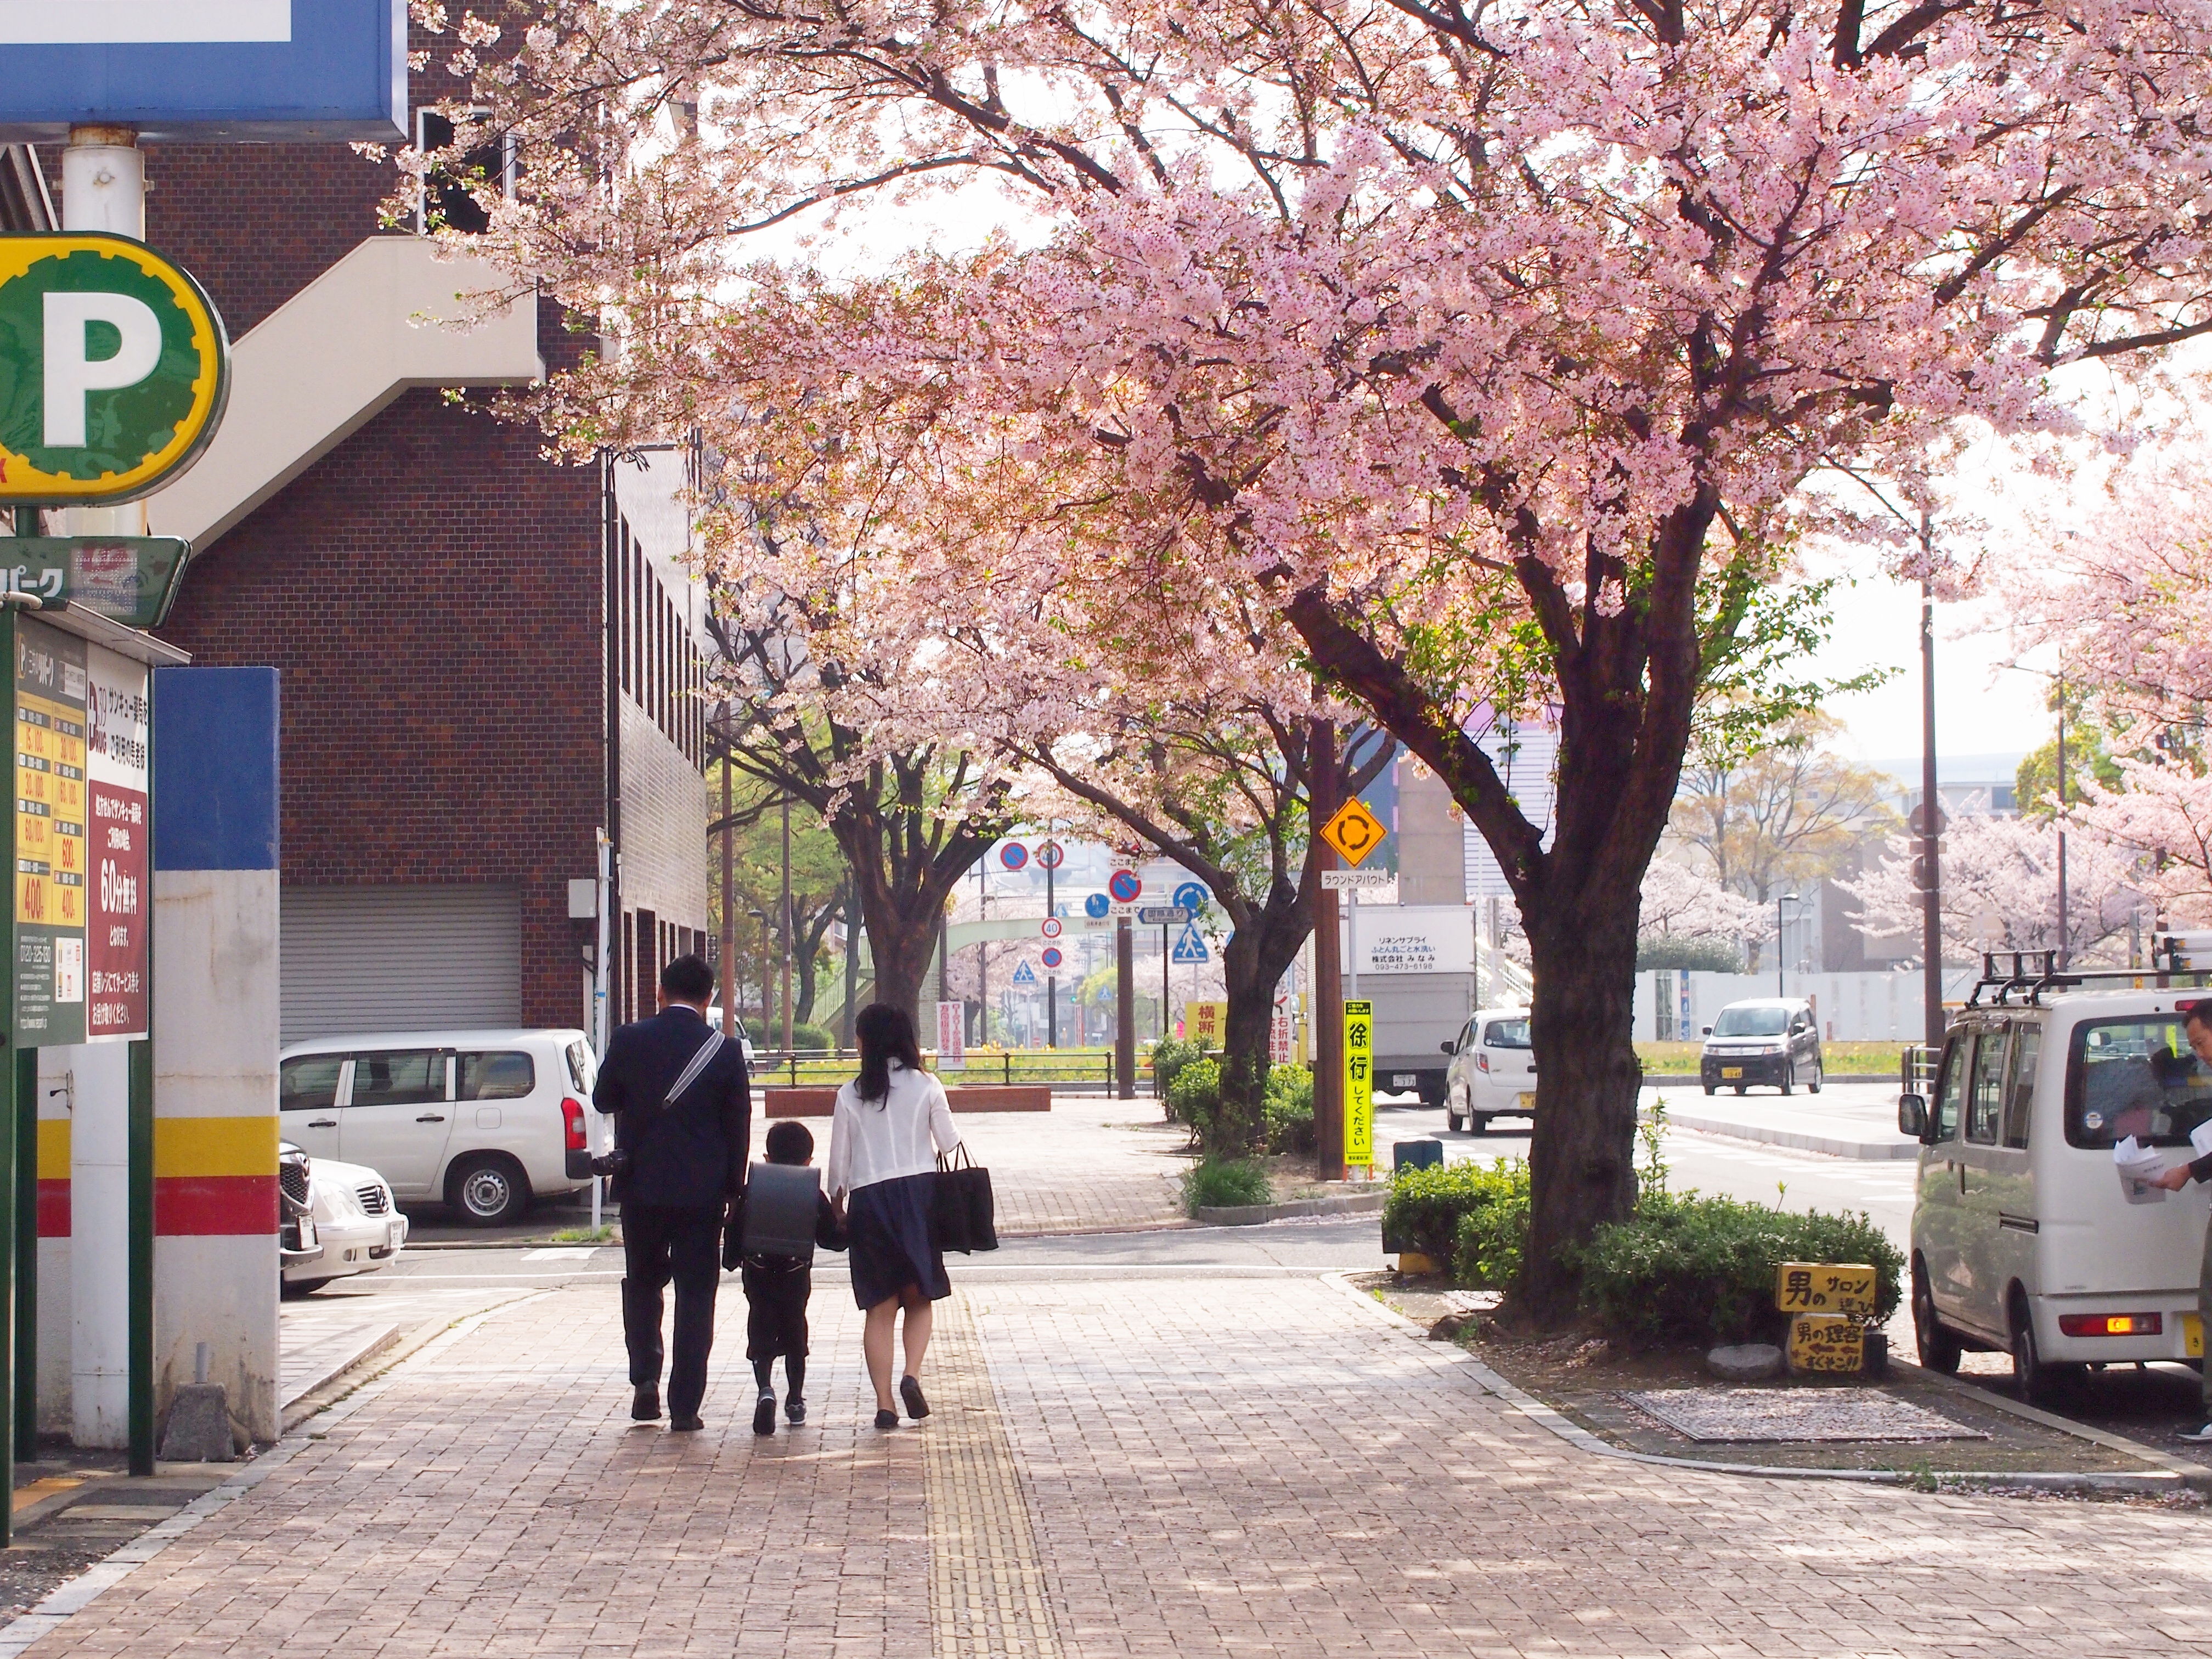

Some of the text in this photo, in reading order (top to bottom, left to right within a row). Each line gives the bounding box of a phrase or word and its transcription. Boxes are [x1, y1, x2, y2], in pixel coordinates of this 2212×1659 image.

[43, 292, 162, 448] P
[101, 857, 137, 915] 60分無料
[1324, 875, 1385, 885] ラウンドアバウト
[1046, 923, 1058, 933] 40
[1372, 955, 1403, 963] 株式会社
[1277, 1017, 1289, 1063] 右折禁止
[1348, 1022, 1368, 1146] 徐行してください
[1797, 1322, 1861, 1344] 男の理容
